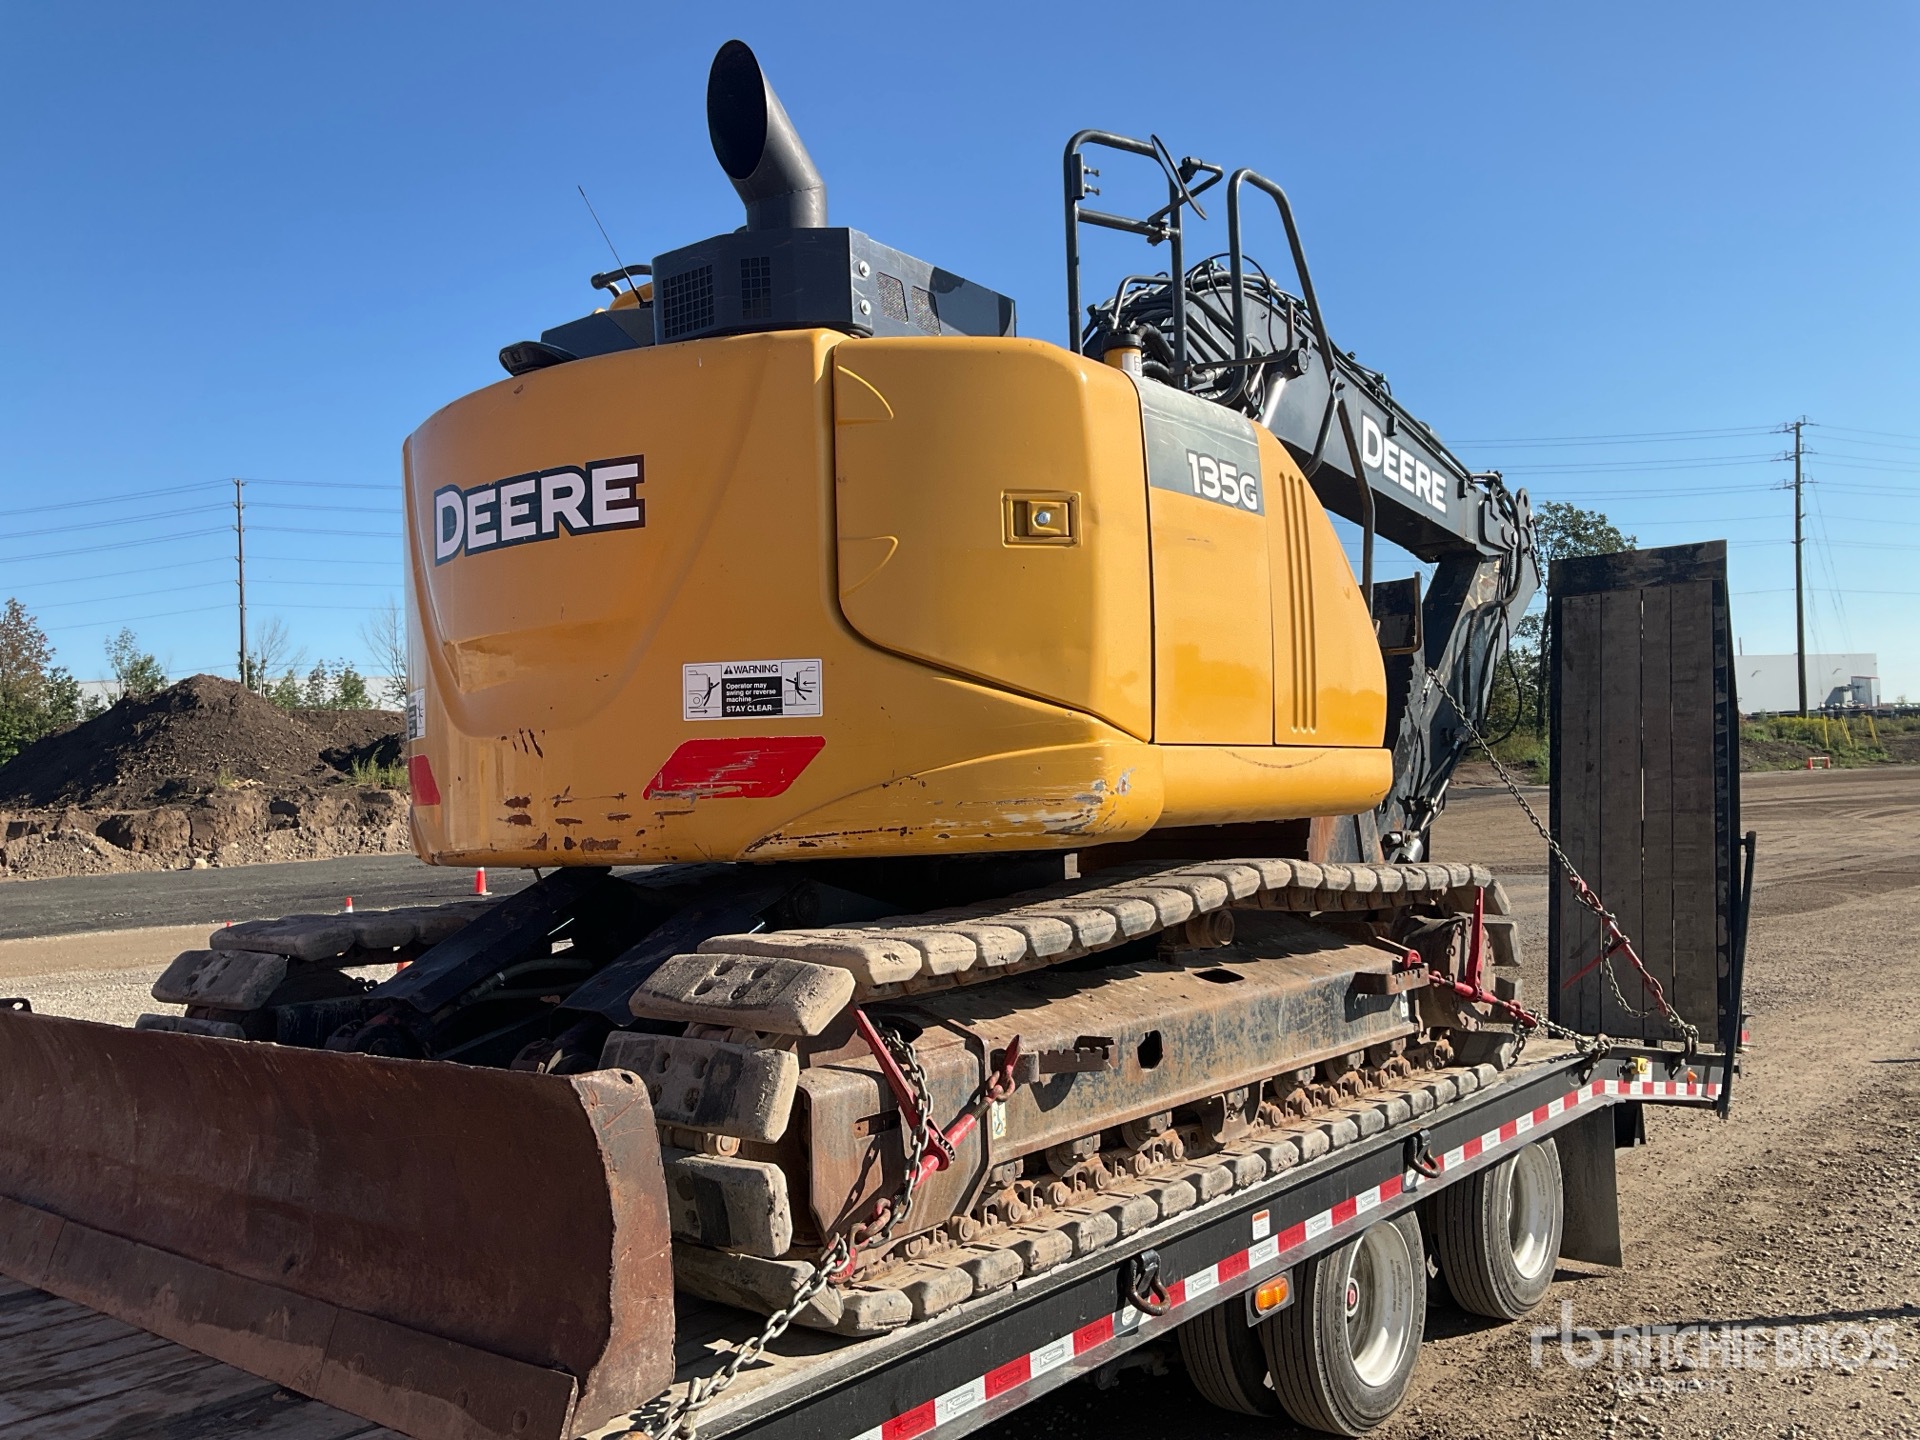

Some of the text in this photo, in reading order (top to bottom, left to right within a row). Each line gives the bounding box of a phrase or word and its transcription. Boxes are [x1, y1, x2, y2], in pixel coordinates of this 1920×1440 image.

[1187, 451, 1258, 511] 135G
[1361, 413, 1448, 514] DEERE
[435, 459, 642, 562] DEERE
[733, 664, 779, 674] WARNING
[726, 695, 752, 703] machine
[747, 704, 773, 712] CLEAR
